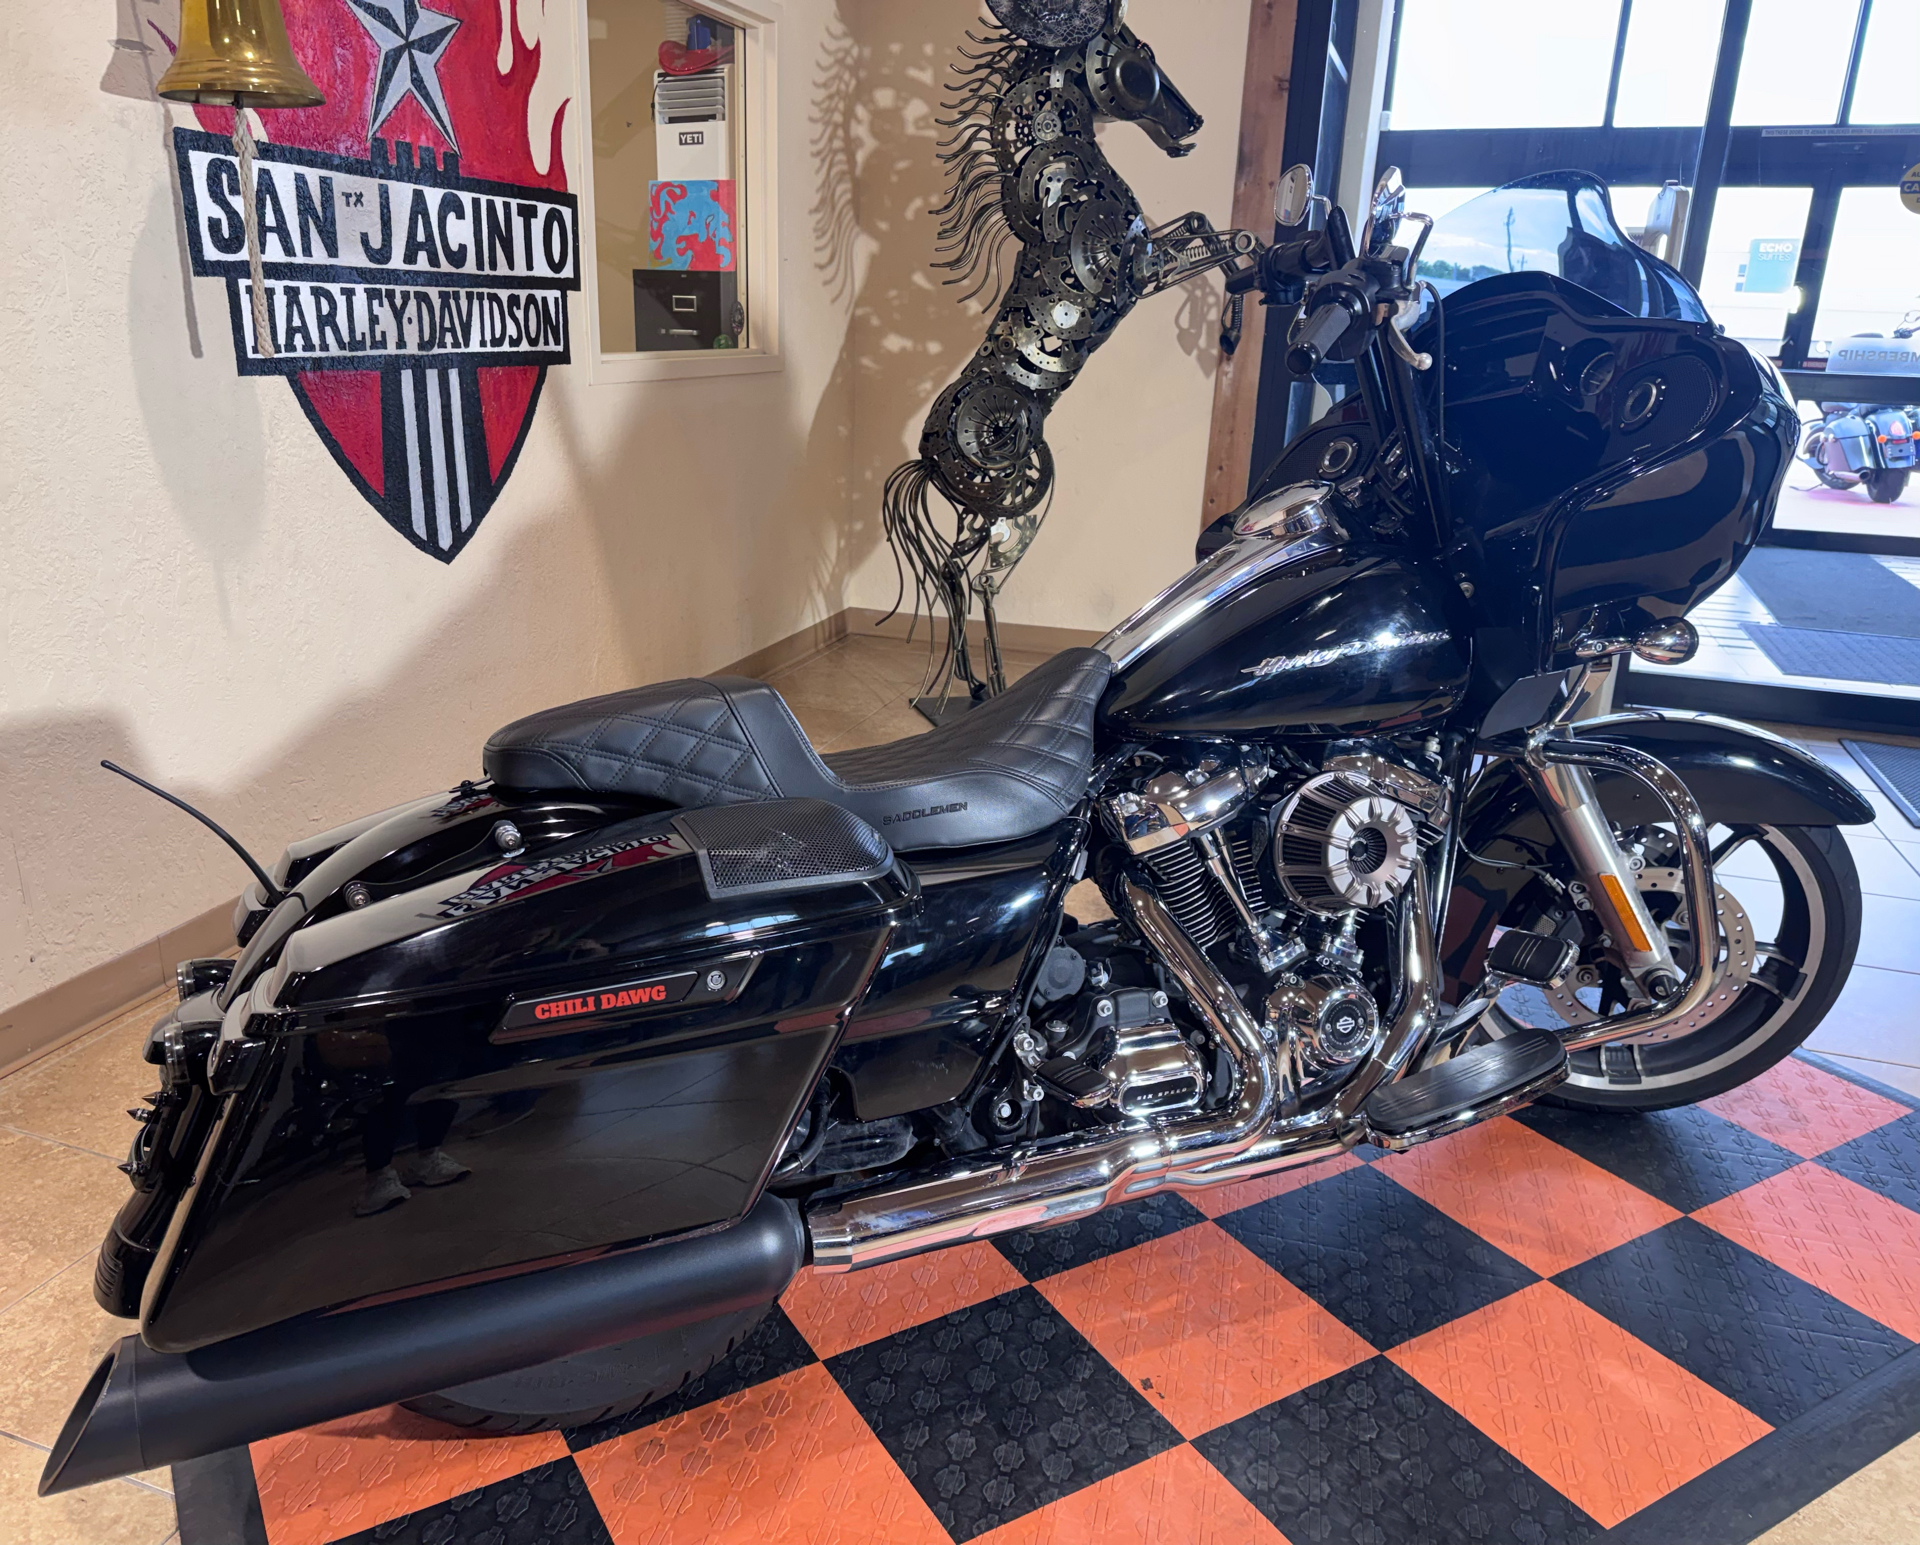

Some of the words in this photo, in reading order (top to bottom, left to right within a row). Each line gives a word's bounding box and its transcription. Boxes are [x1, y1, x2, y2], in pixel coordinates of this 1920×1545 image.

[680, 133, 702, 143] YETI
[341, 190, 364, 208] TX
[206, 157, 338, 258] SAN
[360, 183, 569, 274] JACINTO
[1759, 242, 1793, 253] ECHO
[1757, 252, 1791, 262] SUITES
[882, 801, 968, 826] SADDLEMEN
[534, 996, 596, 1020] CHILI
[599, 984, 667, 1010] DAWG
[1136, 1093, 1153, 1101] SIX
[1157, 1087, 1187, 1097] SPEED
